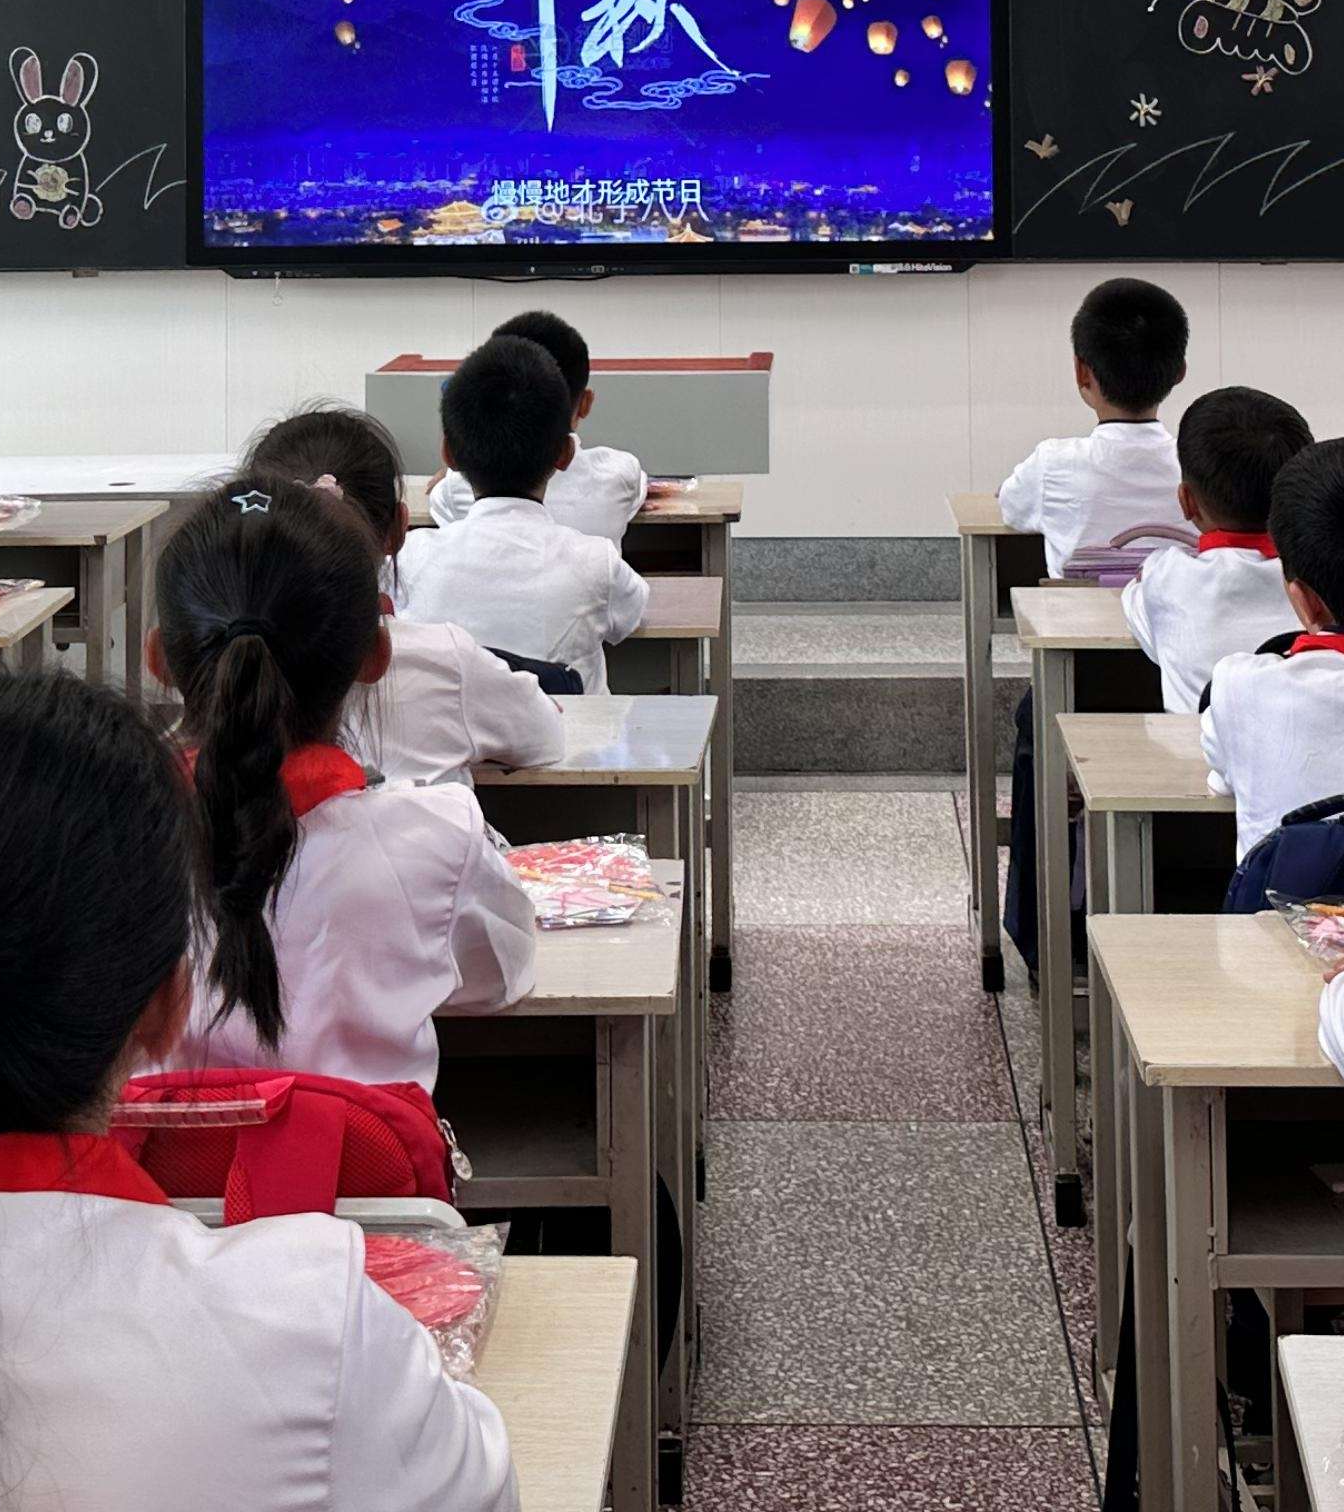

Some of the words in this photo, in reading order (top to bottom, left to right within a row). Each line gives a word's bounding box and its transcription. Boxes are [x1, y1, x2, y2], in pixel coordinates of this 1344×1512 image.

[492, 179, 702, 205] 慢慢地才形成节日
